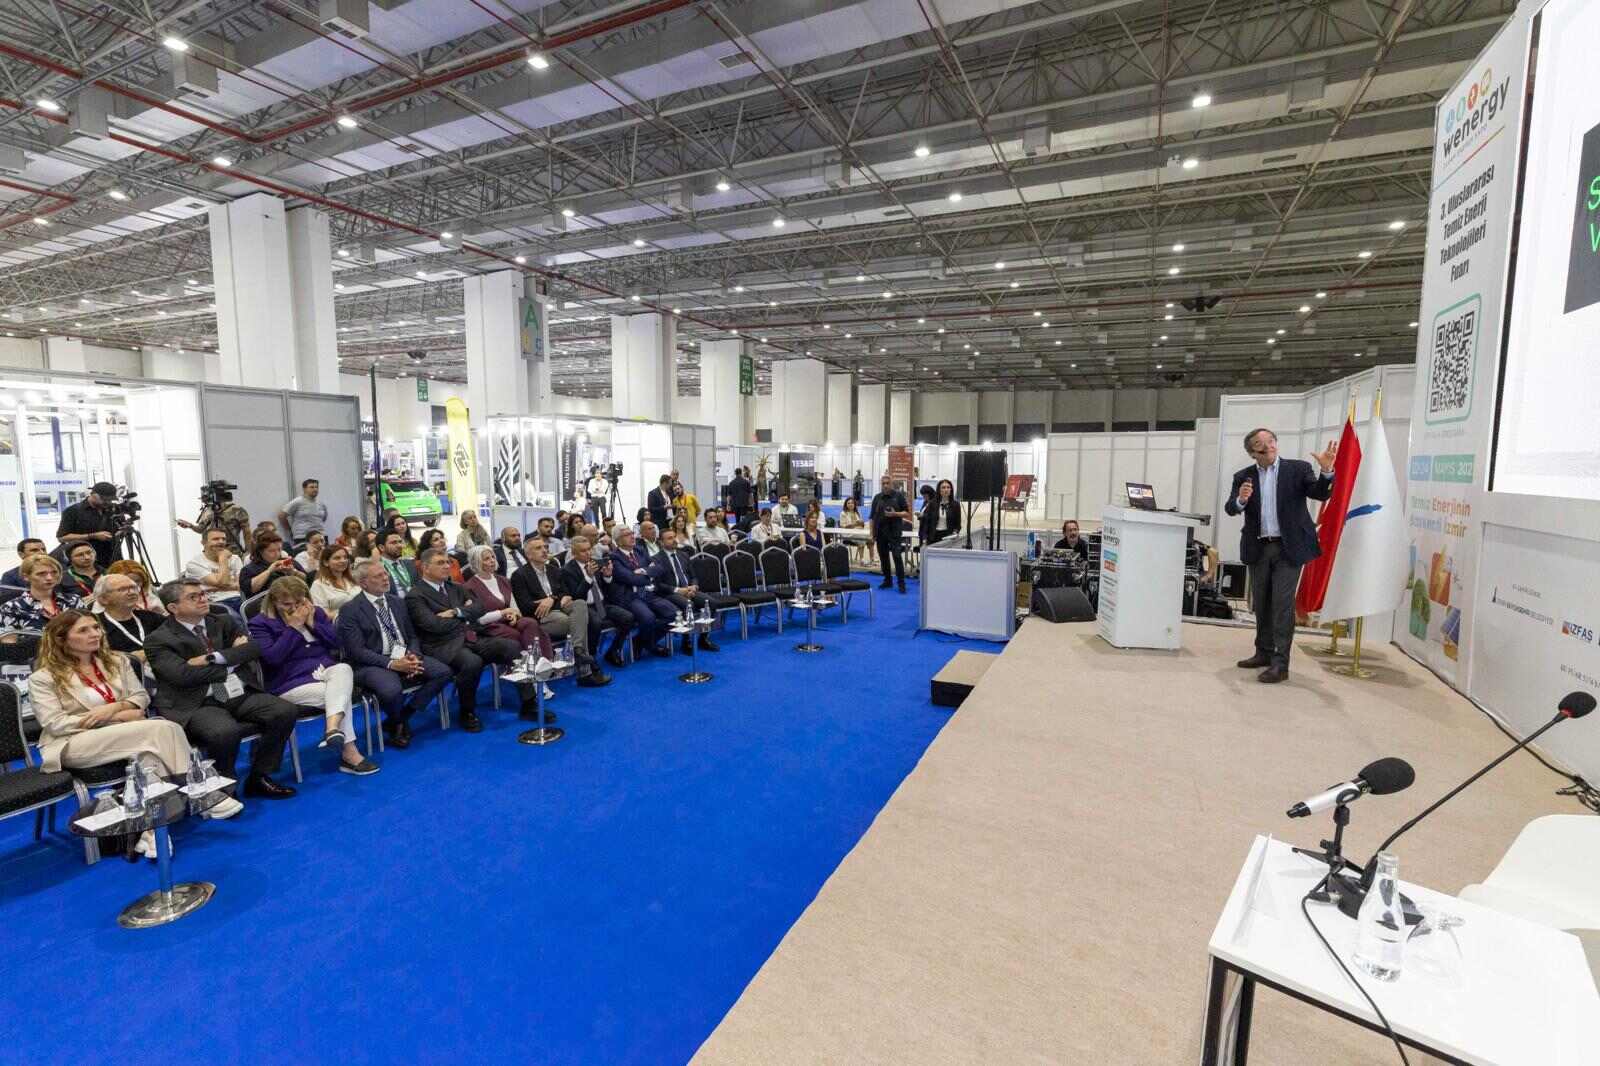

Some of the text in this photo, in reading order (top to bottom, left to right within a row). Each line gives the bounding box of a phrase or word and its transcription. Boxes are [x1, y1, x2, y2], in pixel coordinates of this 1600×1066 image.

[1443, 76, 1511, 158] wenergy
[1448, 163, 1495, 214] Uluslararası
[1444, 192, 1488, 240] Temiz Enerji
[1440, 219, 1487, 266] Teknolojileri
[1451, 258, 1470, 283] Fuarı
[1432, 495, 1472, 517] Enerjinin
